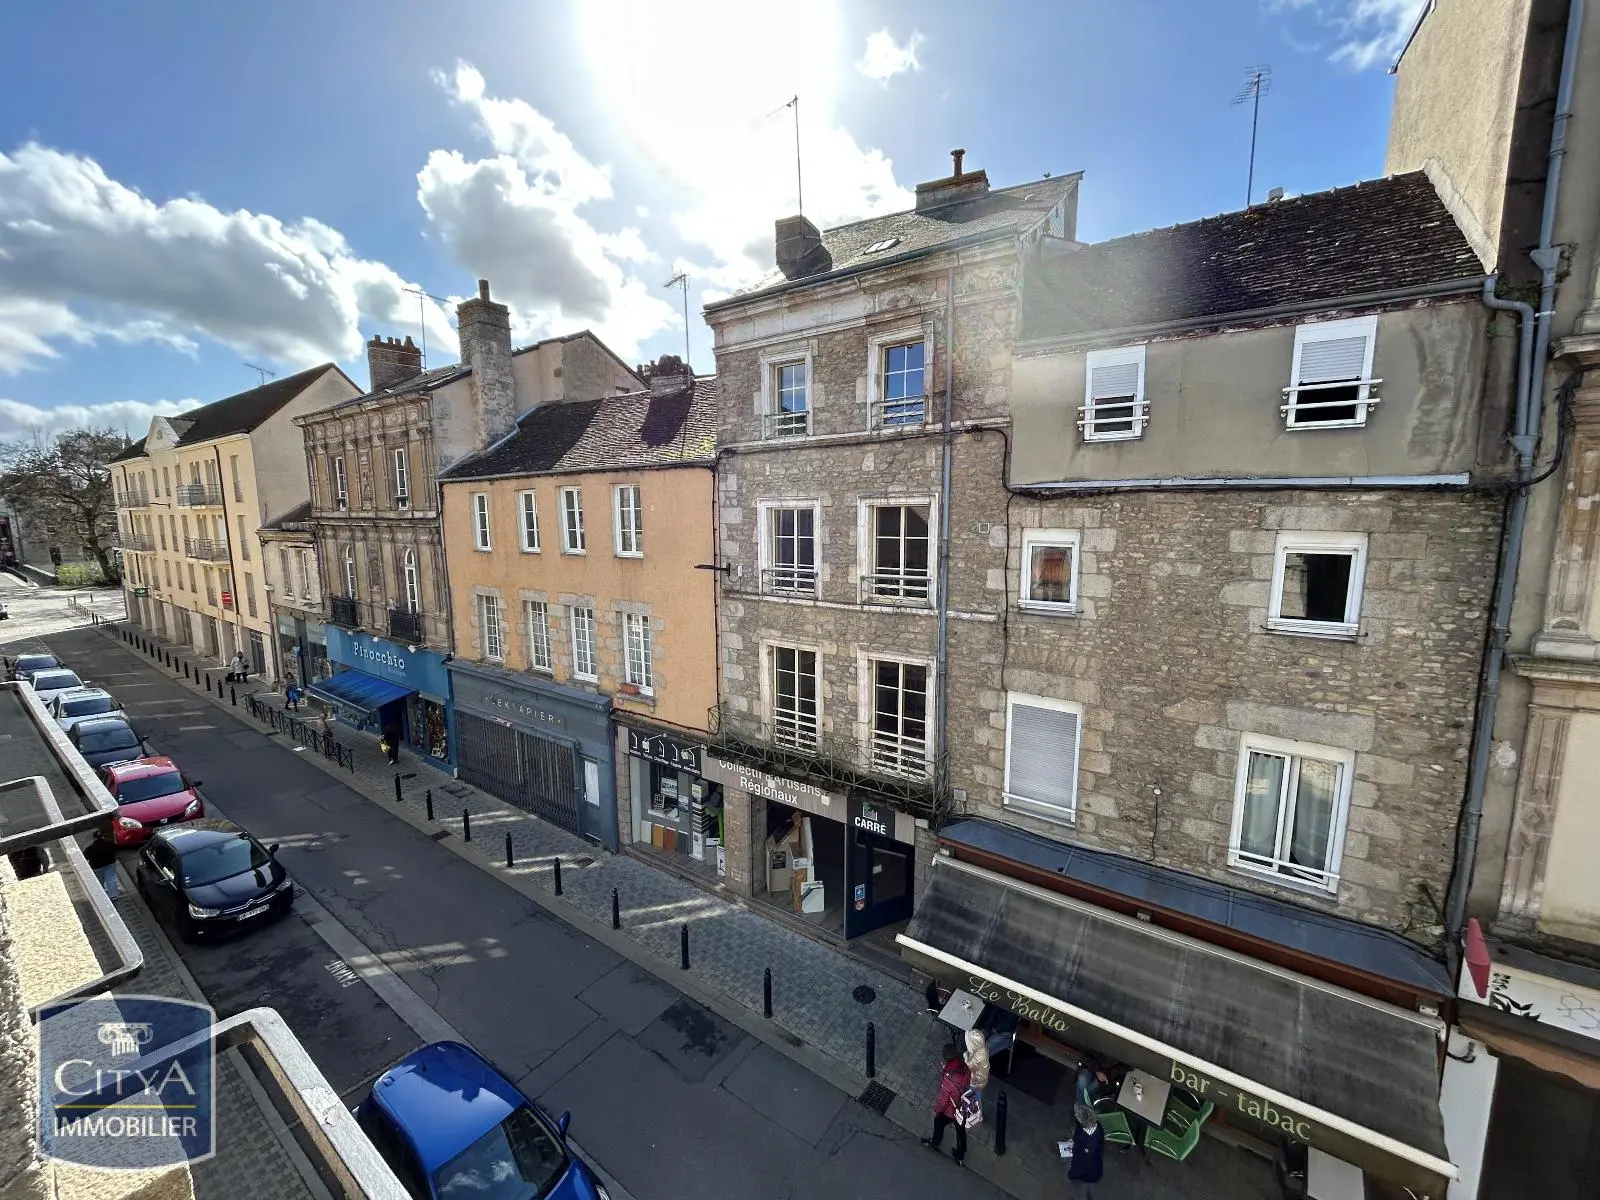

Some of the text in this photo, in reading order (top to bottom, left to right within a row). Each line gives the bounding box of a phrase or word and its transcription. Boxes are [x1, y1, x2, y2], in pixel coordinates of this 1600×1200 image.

[353, 641, 405, 669] Pinocchio
[719, 759, 762, 780] Collectif
[740, 775, 798, 805] Régionaux
[854, 816, 887, 835] CARRÉ
[324, 960, 360, 988] PAYANT
[969, 976, 1070, 1032] Le Balto
[1170, 1059, 1211, 1093] bar
[1236, 1092, 1312, 1140] tabac
